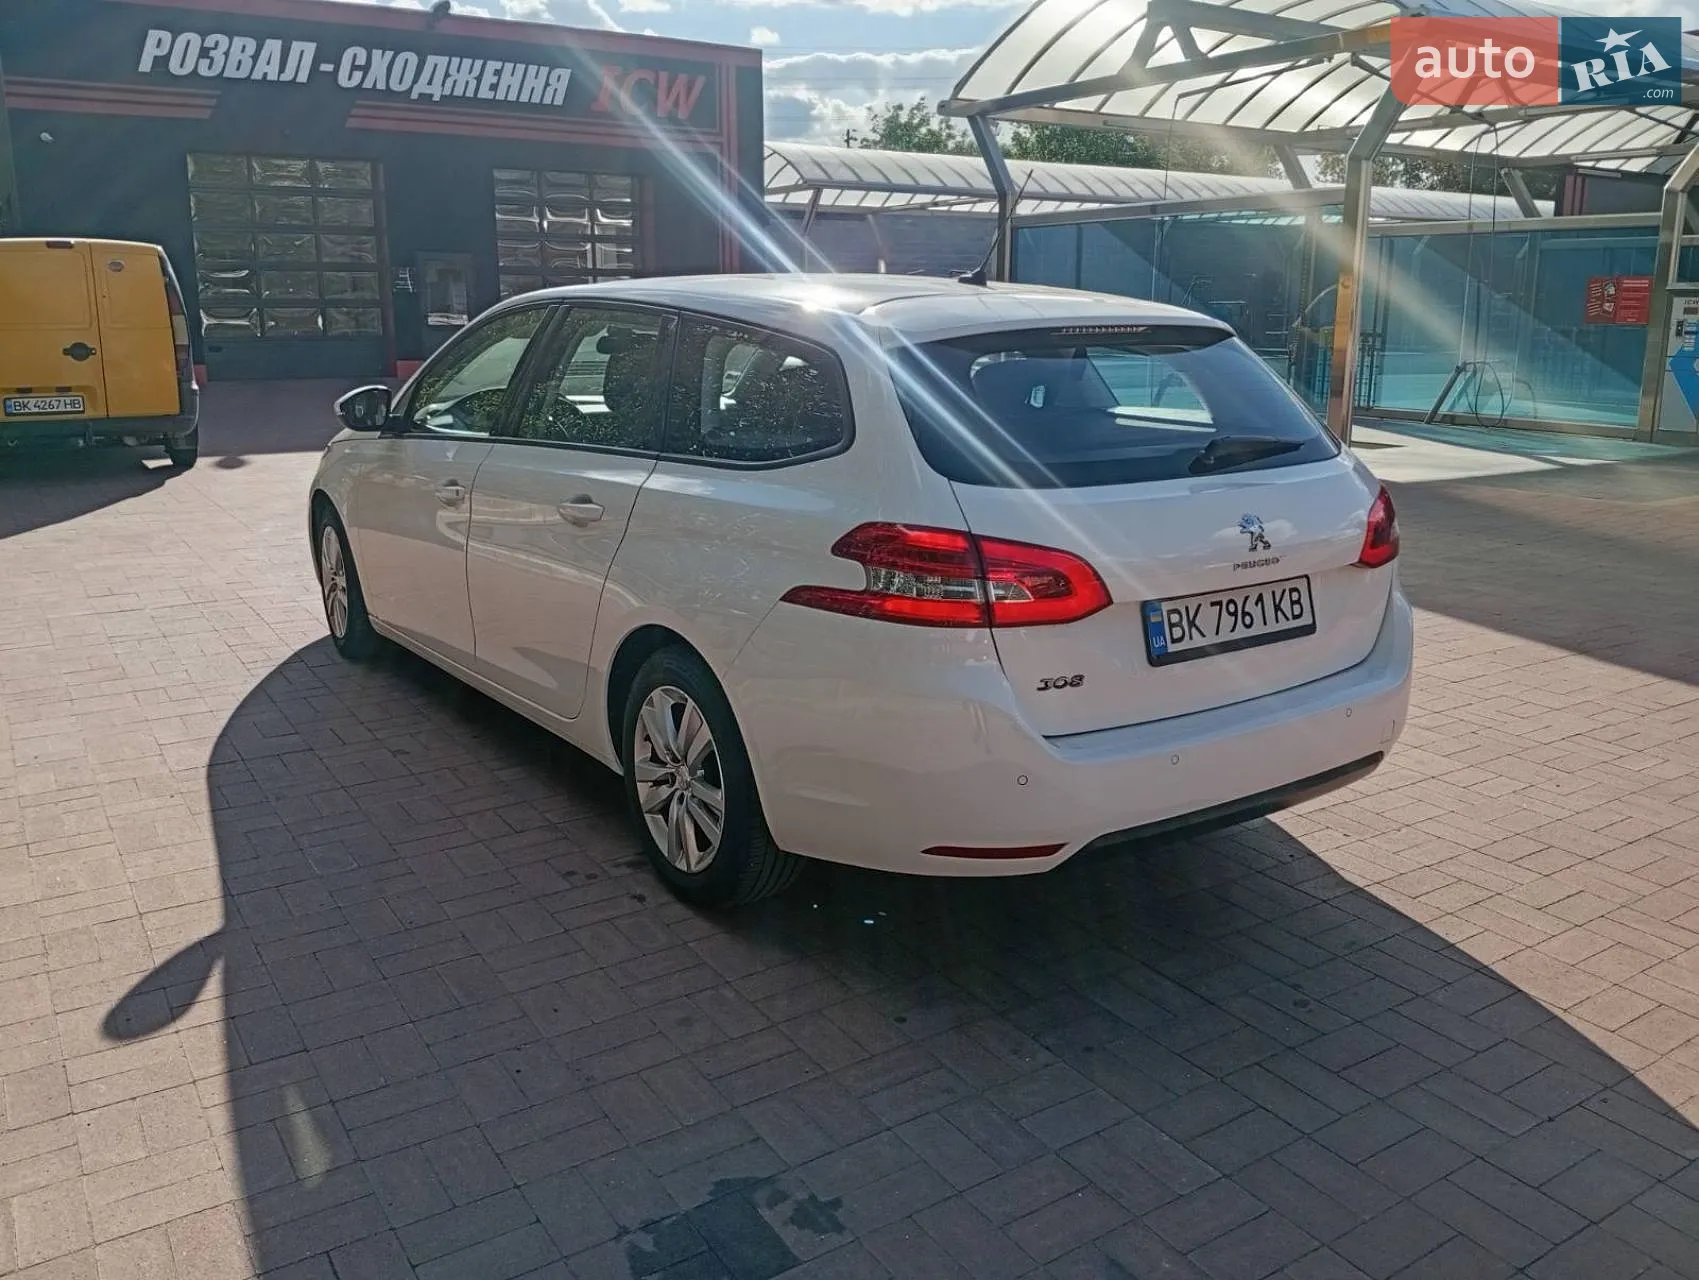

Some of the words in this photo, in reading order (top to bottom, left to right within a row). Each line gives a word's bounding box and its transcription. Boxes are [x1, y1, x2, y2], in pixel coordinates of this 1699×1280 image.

[590, 64, 706, 119] ICW
[13, 400, 32, 411] BK
[33, 399, 61, 411] 4267
[64, 398, 81, 409] HB
[1166, 603, 1207, 644] BK
[1210, 591, 1268, 636] 7961
[1271, 586, 1305, 625] KB
[1153, 635, 1167, 648] UA
